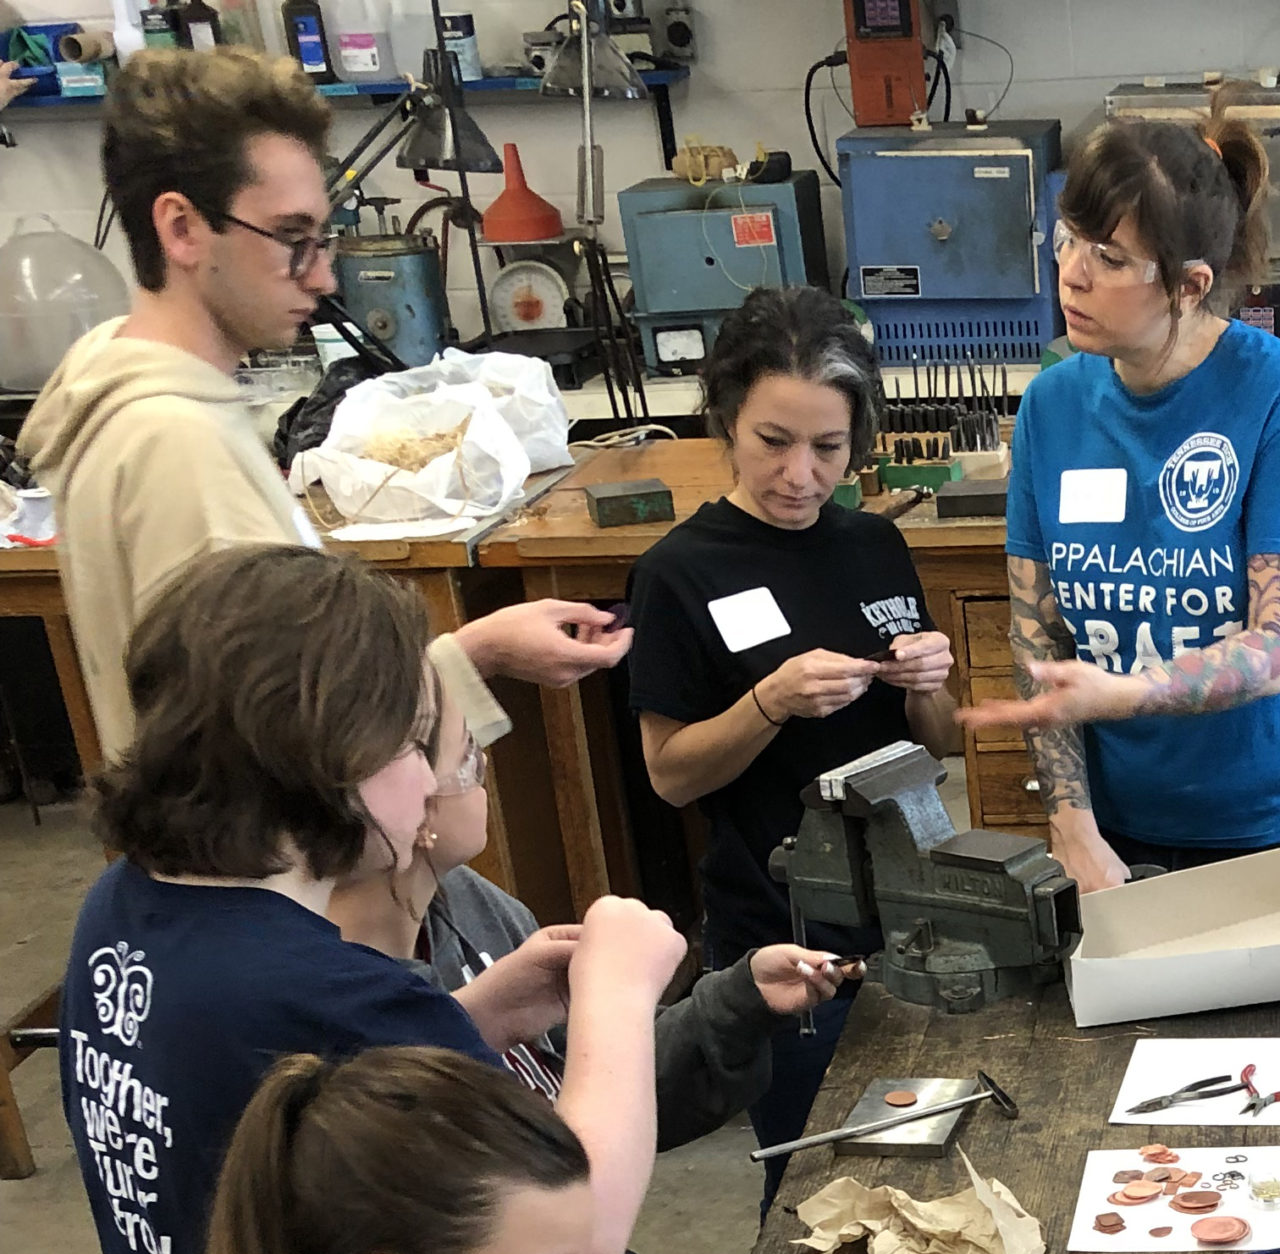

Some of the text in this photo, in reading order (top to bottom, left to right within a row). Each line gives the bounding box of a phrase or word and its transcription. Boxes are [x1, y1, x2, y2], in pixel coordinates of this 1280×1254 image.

[1049, 542, 1235, 578] PPALACHIAN
[1052, 579, 1236, 617] ENTER FOR
